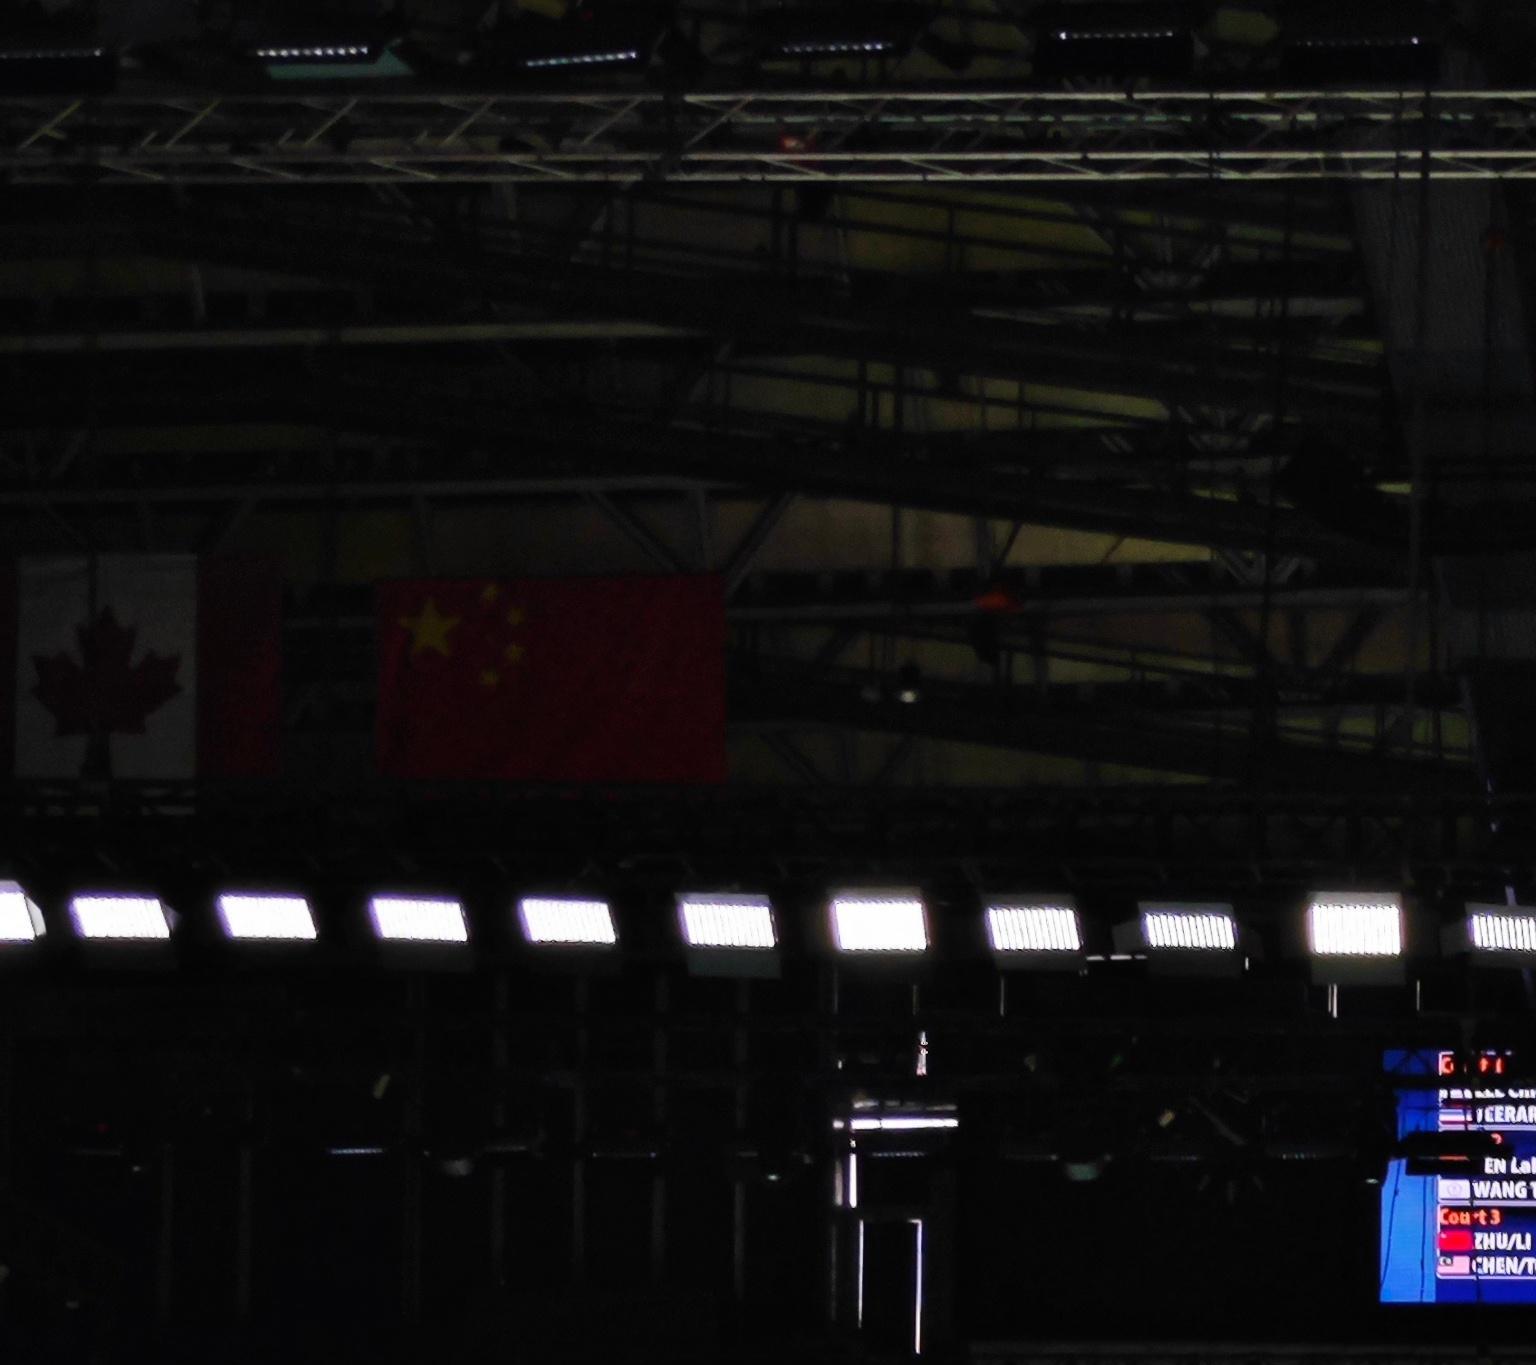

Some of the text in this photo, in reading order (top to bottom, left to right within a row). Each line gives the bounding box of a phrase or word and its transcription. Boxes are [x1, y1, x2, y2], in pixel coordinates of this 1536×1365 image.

[1484, 1157, 1507, 1175] EN
[1473, 1181, 1527, 1199] WANG
[1440, 1209, 1487, 1225] Court
[1490, 1209, 1501, 1225] 3
[1473, 1232, 1532, 1251] ZHU/LI
